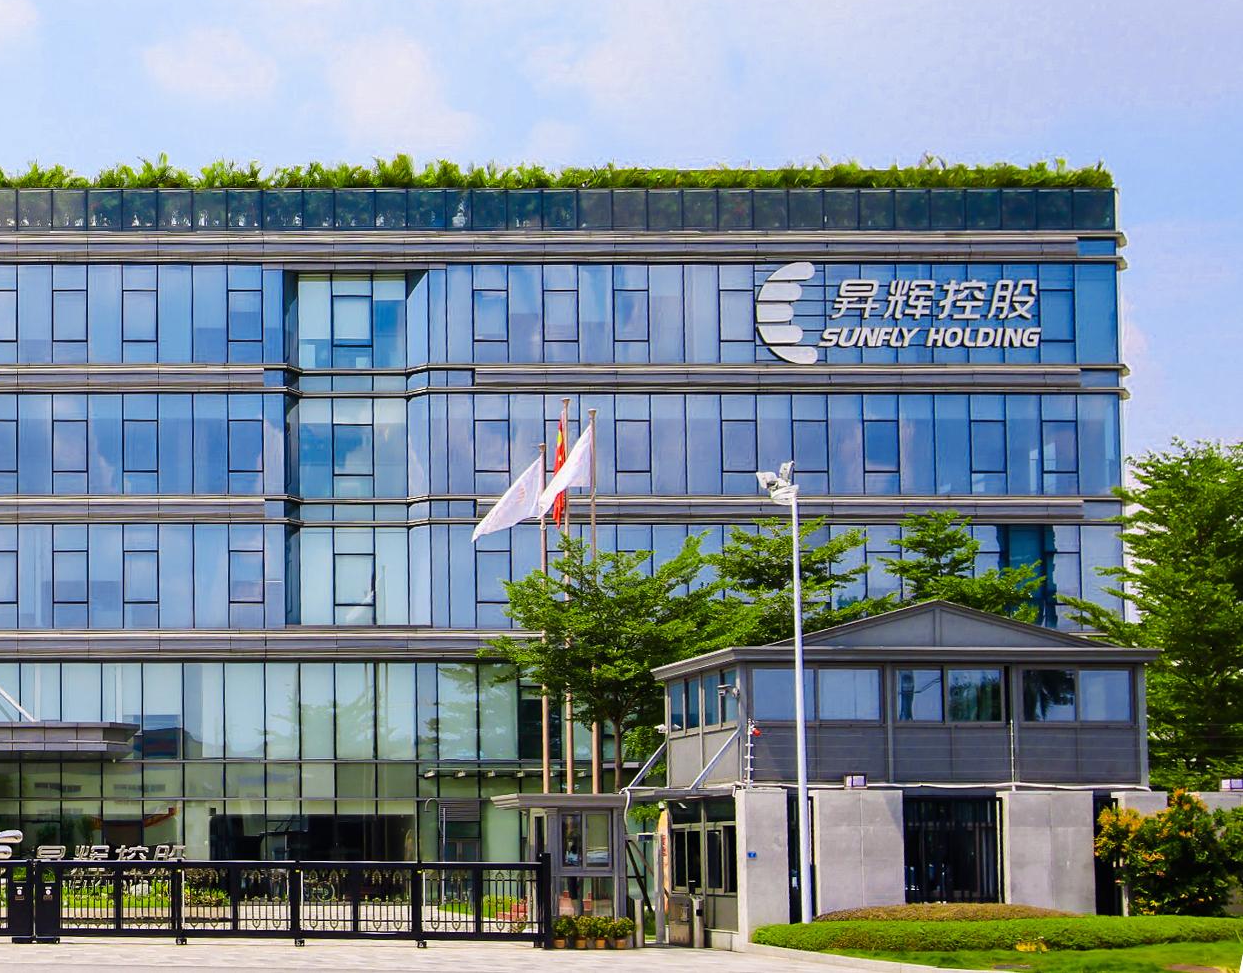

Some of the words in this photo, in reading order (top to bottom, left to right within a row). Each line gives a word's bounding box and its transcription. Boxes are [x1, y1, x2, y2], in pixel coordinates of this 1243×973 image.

[831, 279, 1038, 319] 昇辉控股
[818, 327, 920, 347] SUNFLY
[926, 327, 1041, 347] HOLDING
